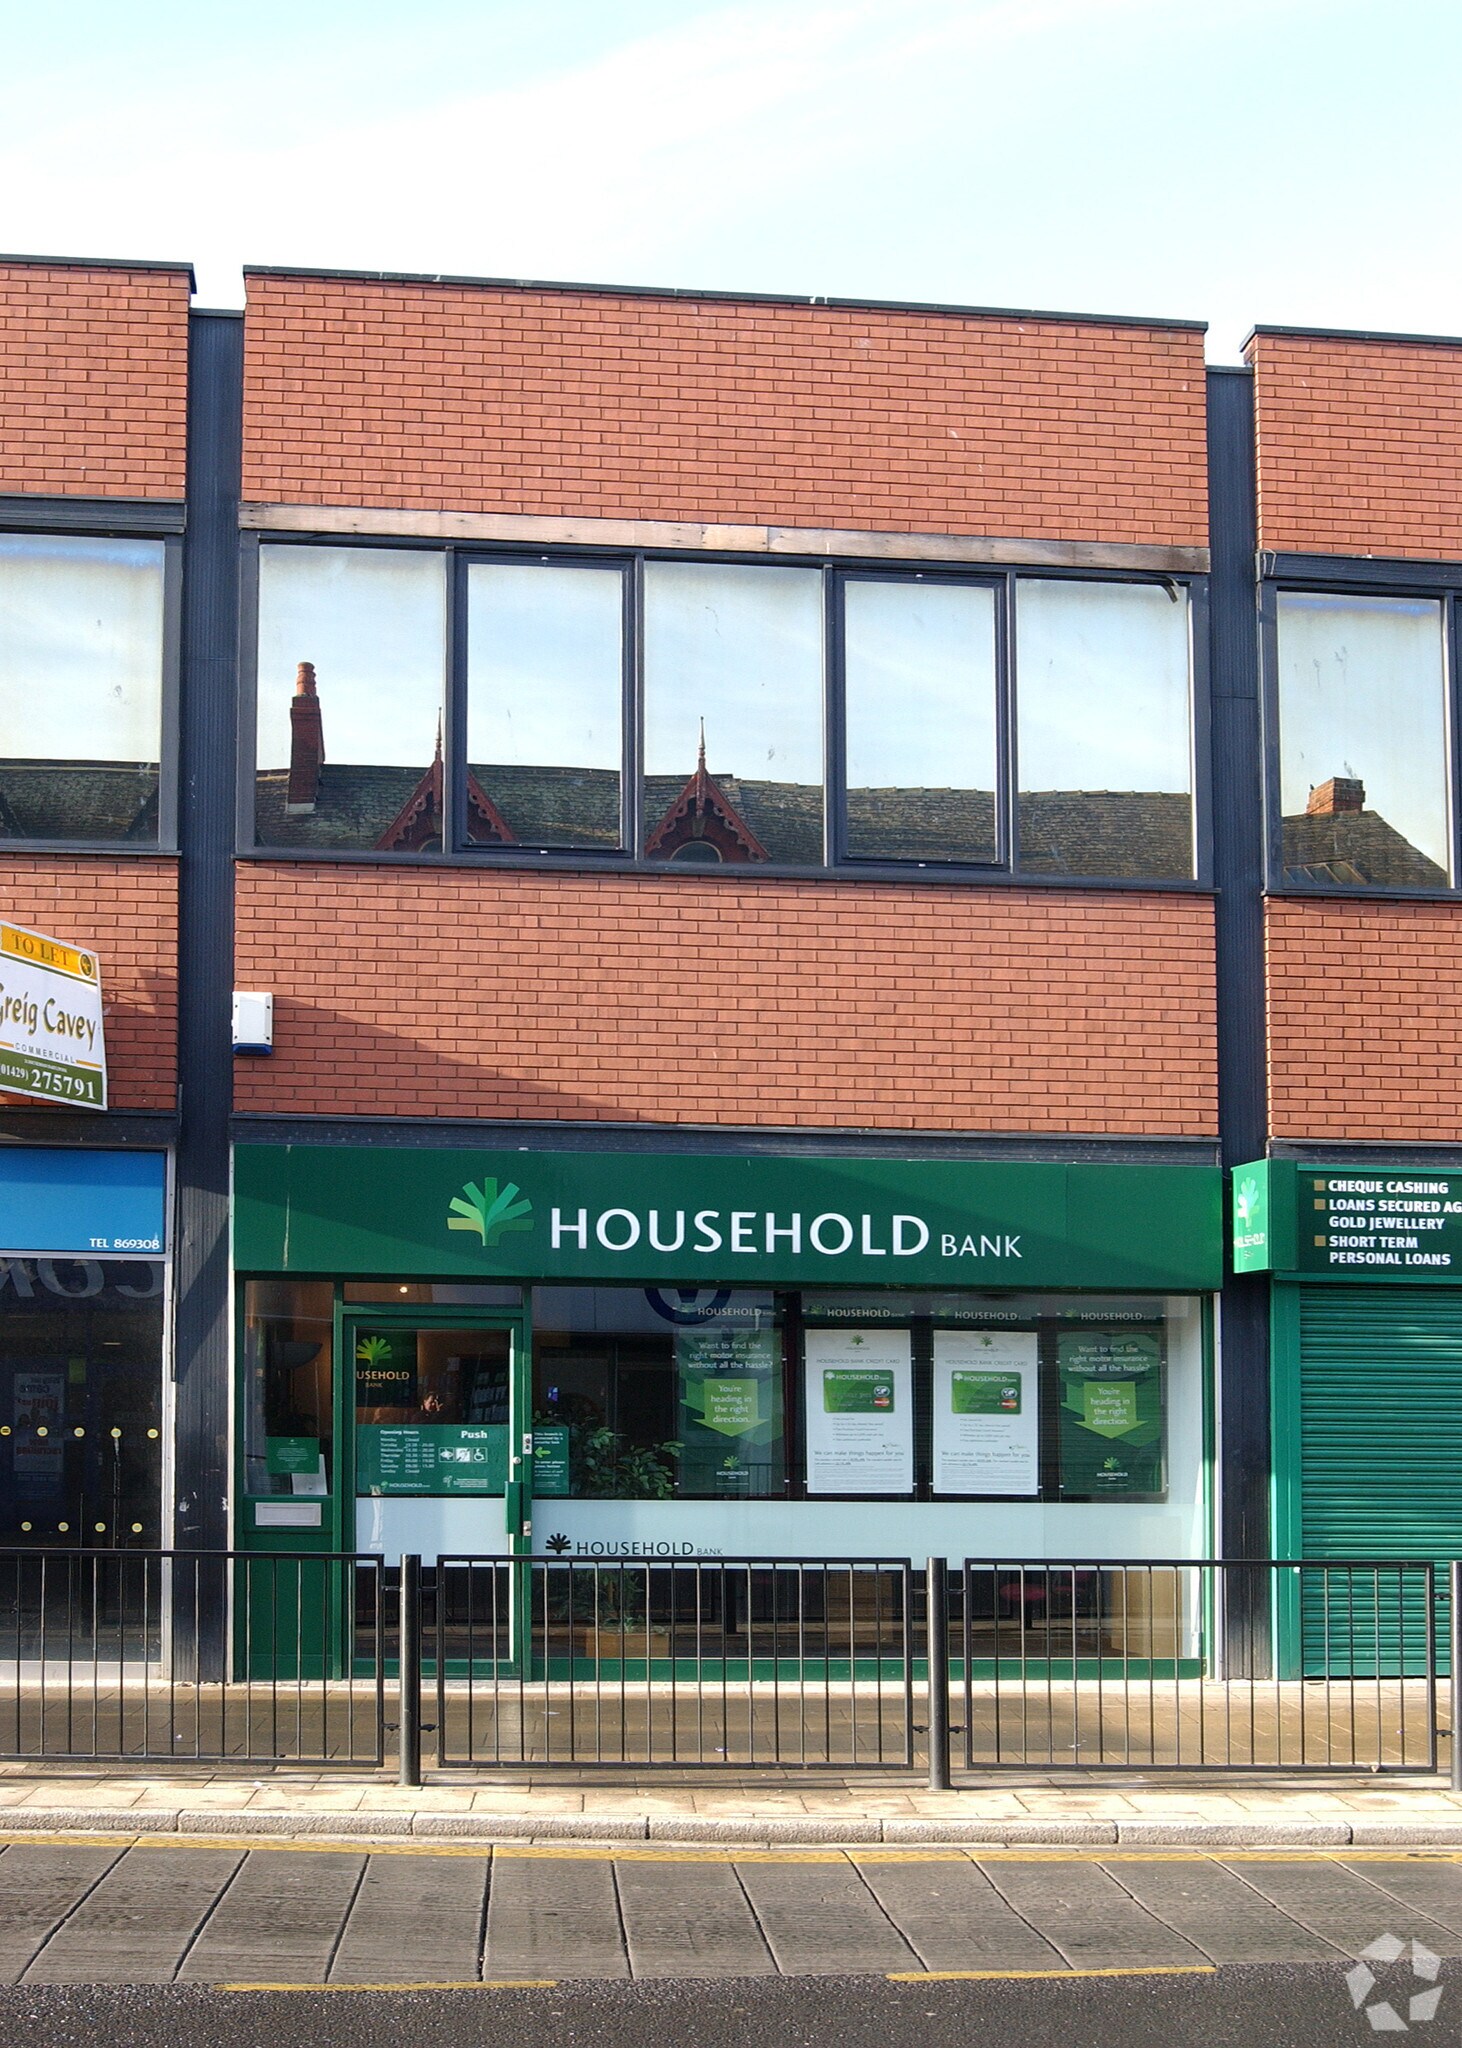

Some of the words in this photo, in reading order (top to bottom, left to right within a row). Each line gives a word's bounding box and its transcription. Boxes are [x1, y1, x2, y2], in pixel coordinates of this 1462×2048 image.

[12, 933, 34, 954] TO
[40, 943, 69, 966] LET
[43, 997, 96, 1052] Cavey
[15, 1042, 75, 1064] COMMERCIAL
[31, 1068, 96, 1099] 275791
[1328, 1180, 1384, 1193] CHEQUE
[1386, 1180, 1449, 1194] CASHING
[1329, 1199, 1375, 1211] LOANS
[1378, 1200, 1441, 1212] SECURED
[1443, 1201, 1462, 1213] AG
[1329, 1216, 1367, 1228] GOLD
[1369, 1217, 1445, 1230] JEWELLERY
[551, 1207, 930, 1257] HOUSEHOLD
[941, 1234, 1023, 1258] BANK
[89, 1238, 109, 1248] TEL
[113, 1239, 160, 1249] 869308
[1329, 1235, 1377, 1248] SHORT
[1379, 1236, 1418, 1248] TERM
[1329, 1252, 1403, 1264] PERSONAL
[1405, 1253, 1451, 1265] LOANS
[698, 1307, 762, 1316] HOUSEHOLD
[827, 1308, 891, 1317] HOUSEHOLD
[954, 1311, 1018, 1320] HOUSEHOLD
[1080, 1312, 1143, 1320] HOUSEHOLD
[1078, 1345, 1098, 1353] Want
[1099, 1345, 1108, 1353] to
[1109, 1345, 1125, 1353] find
[1125, 1345, 1138, 1353] the
[689, 1352, 708, 1361] right
[1069, 1355, 1088, 1365] right
[688, 1361, 717, 1369] without
[719, 1361, 729, 1369] all
[730, 1361, 743, 1369] the
[745, 1361, 773, 1369] hassle?
[1067, 1364, 1097, 1372] without
[1098, 1364, 1107, 1372] all
[1108, 1364, 1122, 1372] the
[1123, 1364, 1150, 1372] hassle?
[718, 1384, 742, 1392] You're
[1097, 1387, 1120, 1395] You're
[710, 1395, 743, 1404] heading
[743, 1395, 752, 1403] in
[1090, 1398, 1122, 1407] heading
[714, 1405, 728, 1413] the
[729, 1405, 749, 1414] right
[1108, 1408, 1127, 1417] right
[712, 1415, 750, 1423] direction.
[461, 1430, 488, 1439] Push
[576, 1541, 694, 1555] HOUSEHOLD
[696, 1548, 723, 1556] BANK
